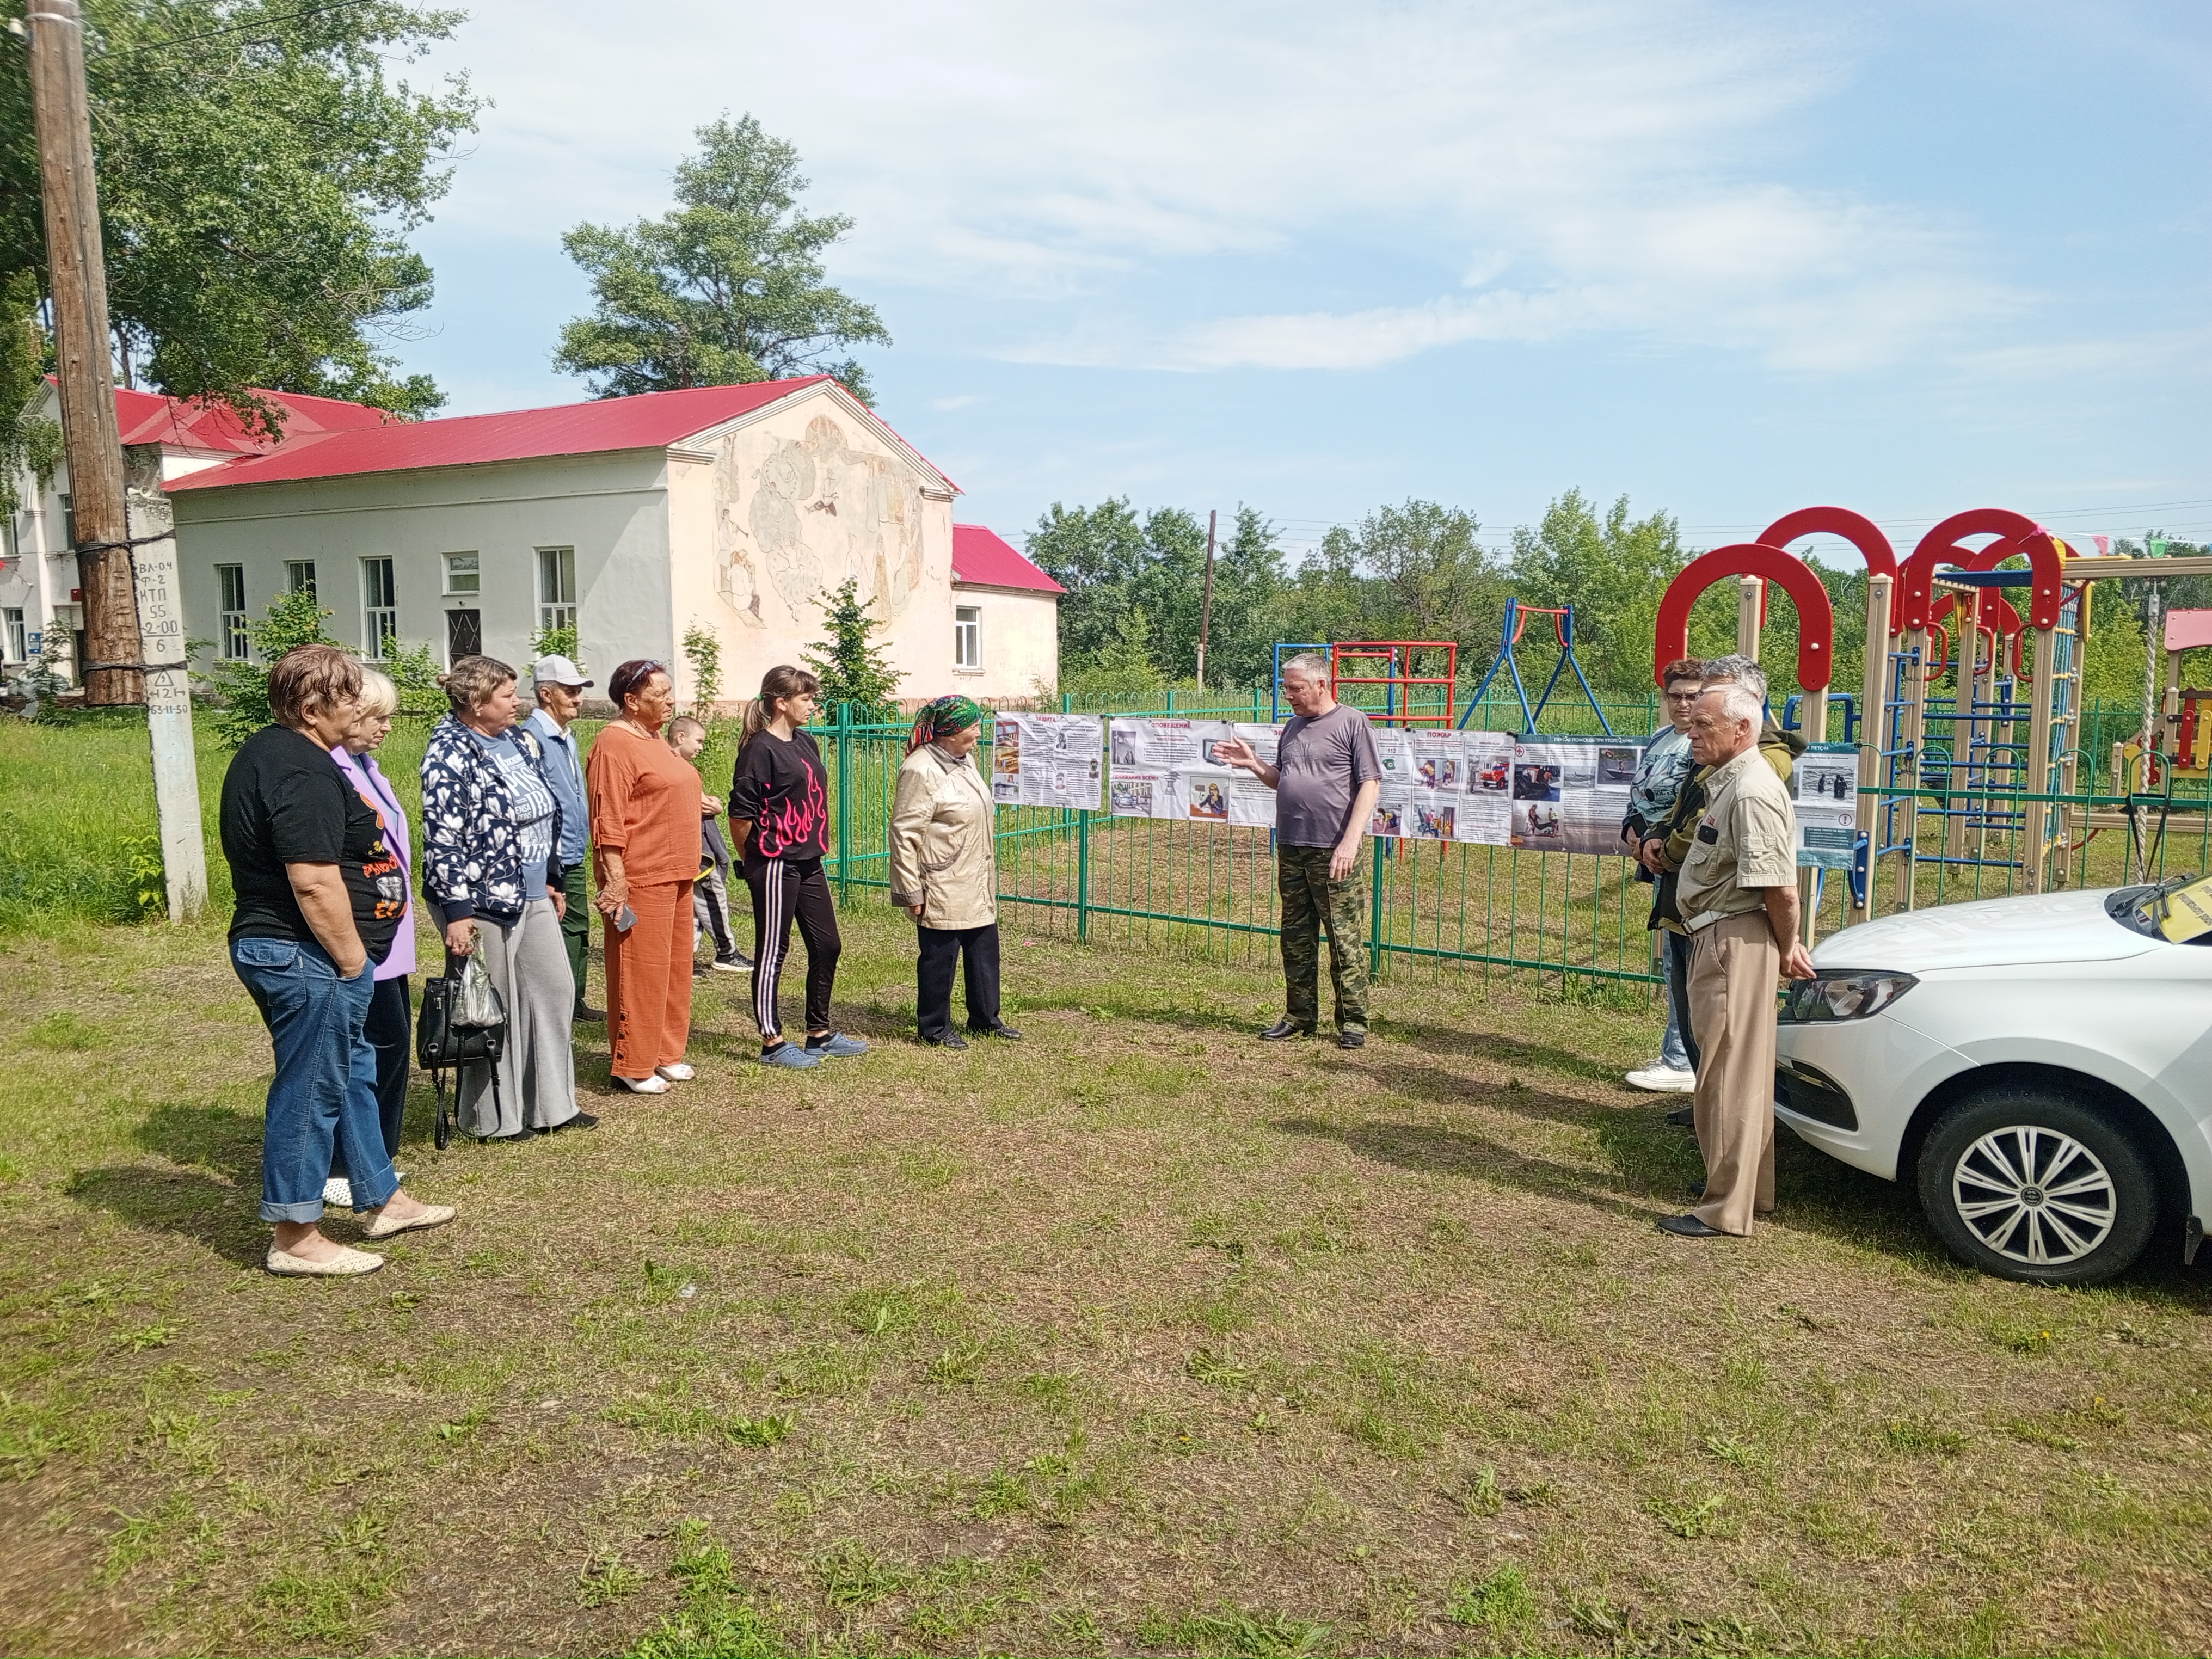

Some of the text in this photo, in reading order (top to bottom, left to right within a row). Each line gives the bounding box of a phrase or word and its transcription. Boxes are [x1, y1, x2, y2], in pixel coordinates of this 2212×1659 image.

[139, 588, 167, 603] КТП
[149, 604, 167, 619] 55
[156, 638, 165, 653] 6
